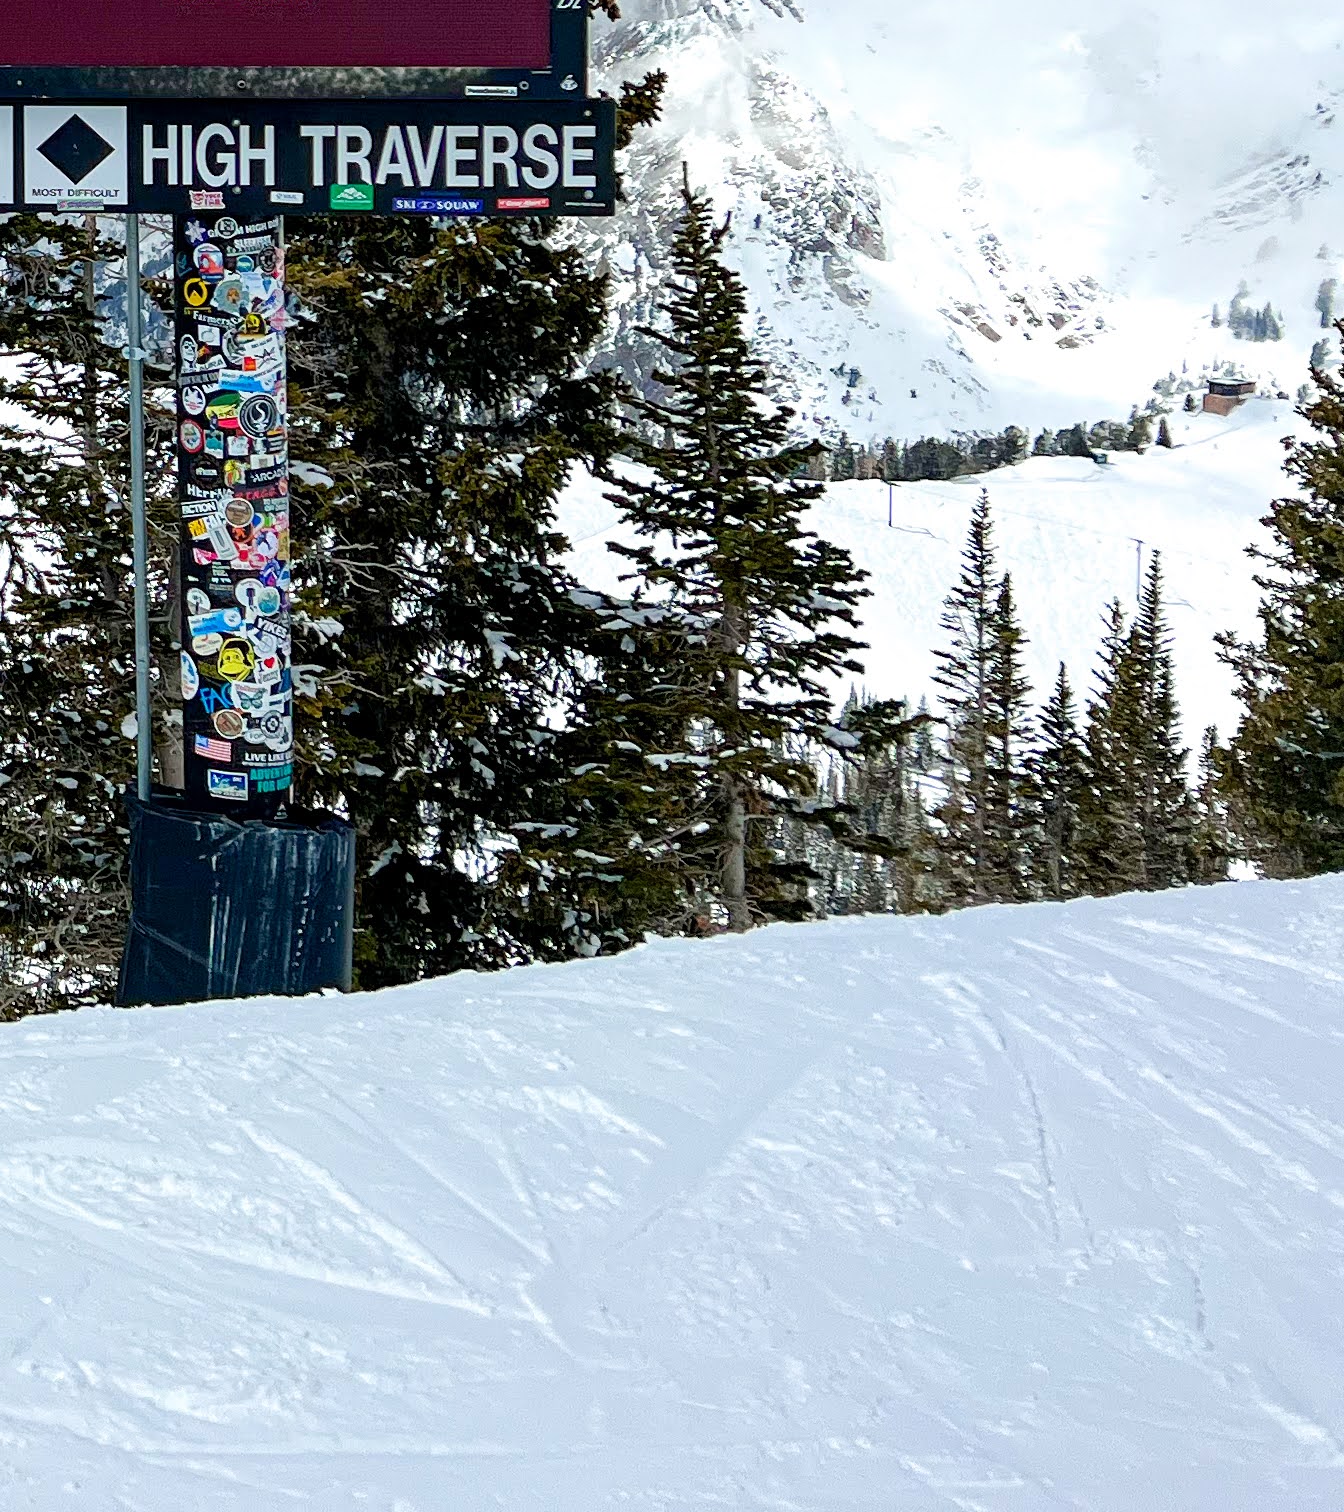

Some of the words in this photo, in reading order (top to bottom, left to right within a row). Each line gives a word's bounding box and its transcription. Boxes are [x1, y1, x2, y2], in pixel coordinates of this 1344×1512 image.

[142, 123, 275, 187] HIGH
[300, 123, 597, 189] TRAVERSE
[32, 188, 63, 197] MOST
[67, 188, 120, 198] DIFFICULT
[396, 199, 416, 210] SKI
[436, 200, 480, 211] SQUAW
[257, 617, 288, 639] YIKES
[244, 752, 268, 763] LIVE
